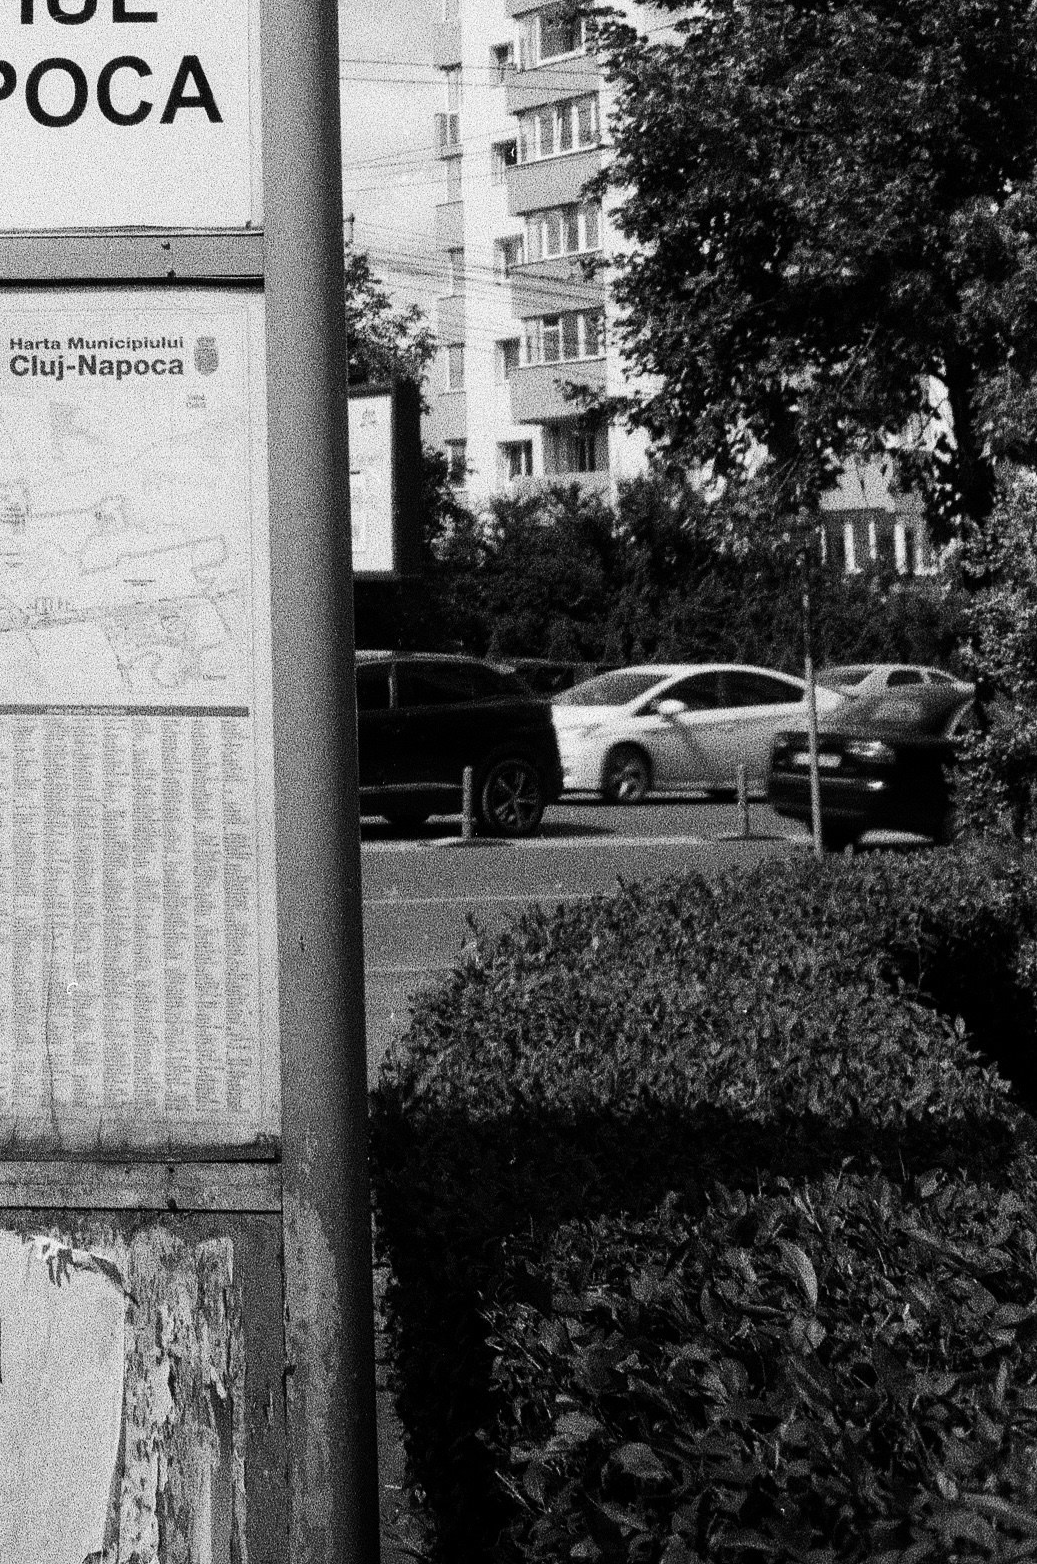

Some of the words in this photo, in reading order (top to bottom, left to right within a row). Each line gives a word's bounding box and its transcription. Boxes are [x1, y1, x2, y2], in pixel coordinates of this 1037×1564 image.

[9, 338, 61, 350] Harta
[67, 336, 184, 352] Municipiului
[9, 354, 184, 381] Cluj-Napoca
